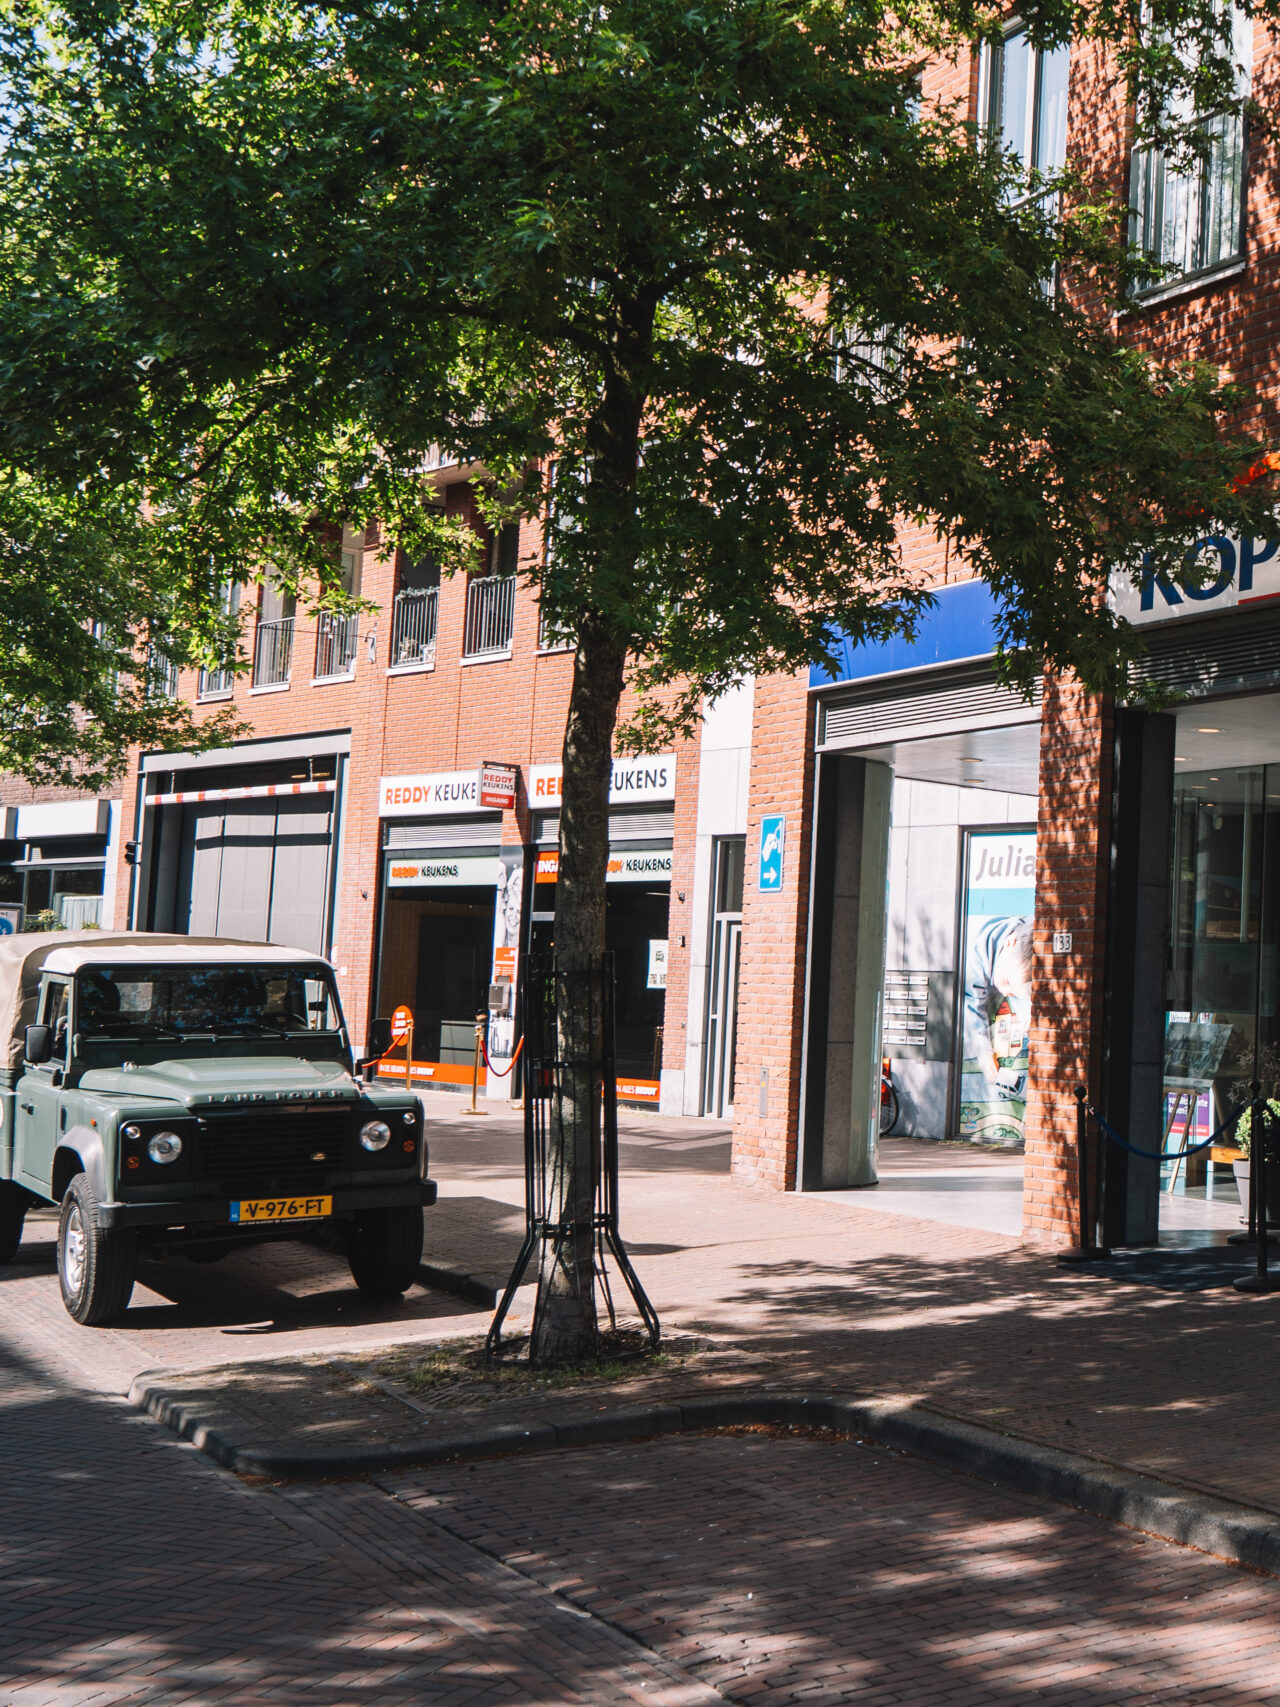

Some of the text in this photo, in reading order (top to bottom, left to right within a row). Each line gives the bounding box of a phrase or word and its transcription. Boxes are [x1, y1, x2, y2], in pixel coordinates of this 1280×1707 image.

[483, 773, 513, 784] REDDY
[386, 781, 477, 805] REDDY KEUKE
[483, 781, 514, 791] KEUKENS
[485, 795, 510, 805] INGANG
[421, 864, 459, 878] KEUKENS
[626, 857, 672, 872] KEUKENS
[1055, 934, 1071, 951] 133
[208, 1090, 344, 1103] LAND ROVER
[247, 1198, 325, 1218] V-976-FT
